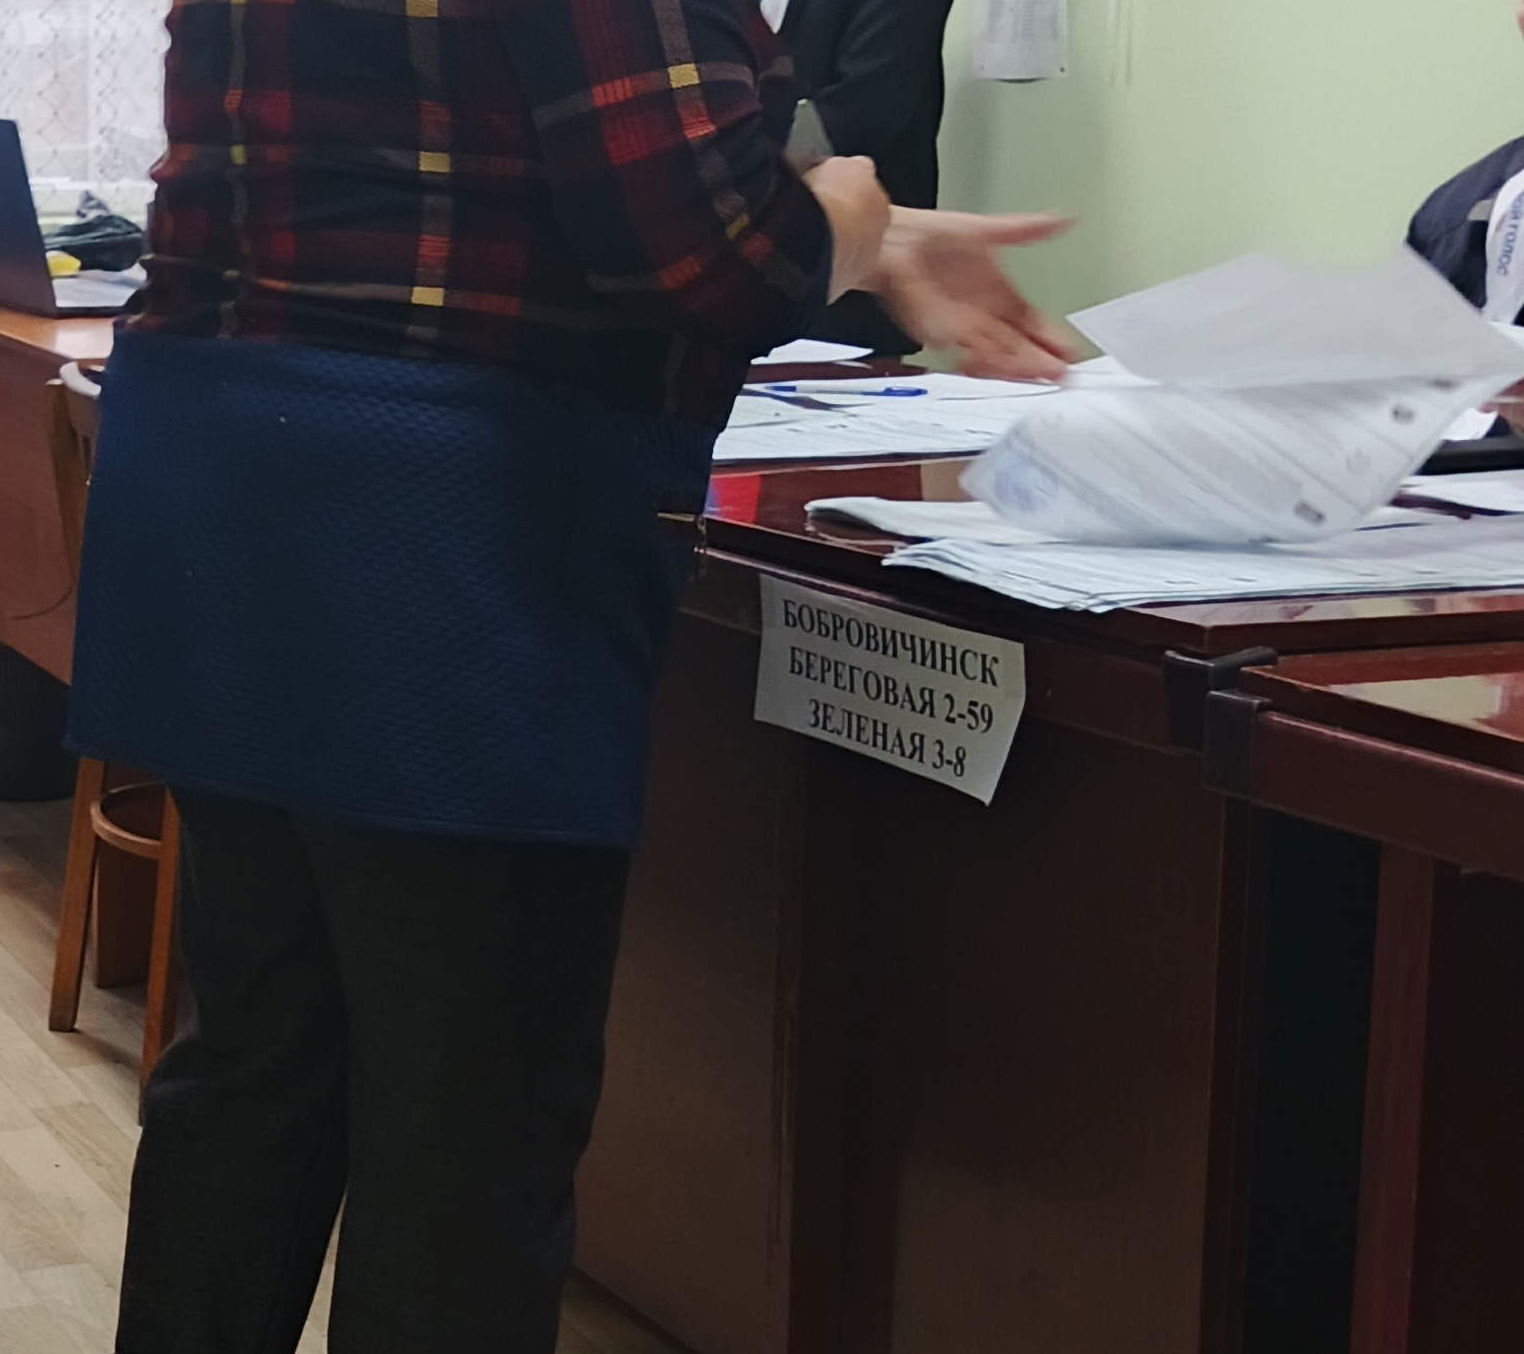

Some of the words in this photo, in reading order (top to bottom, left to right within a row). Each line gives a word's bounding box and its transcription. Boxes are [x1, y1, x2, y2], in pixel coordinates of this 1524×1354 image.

[1497, 222, 1518, 276] ГОЛОС
[782, 598, 1000, 687] БОБРОВИЧИНСК
[789, 646, 937, 718] БЕРЕГОВАЯ
[943, 693, 994, 733] 2-59
[808, 698, 926, 764] ЗЕЛЕНАЯ
[931, 739, 967, 777] 3-8
